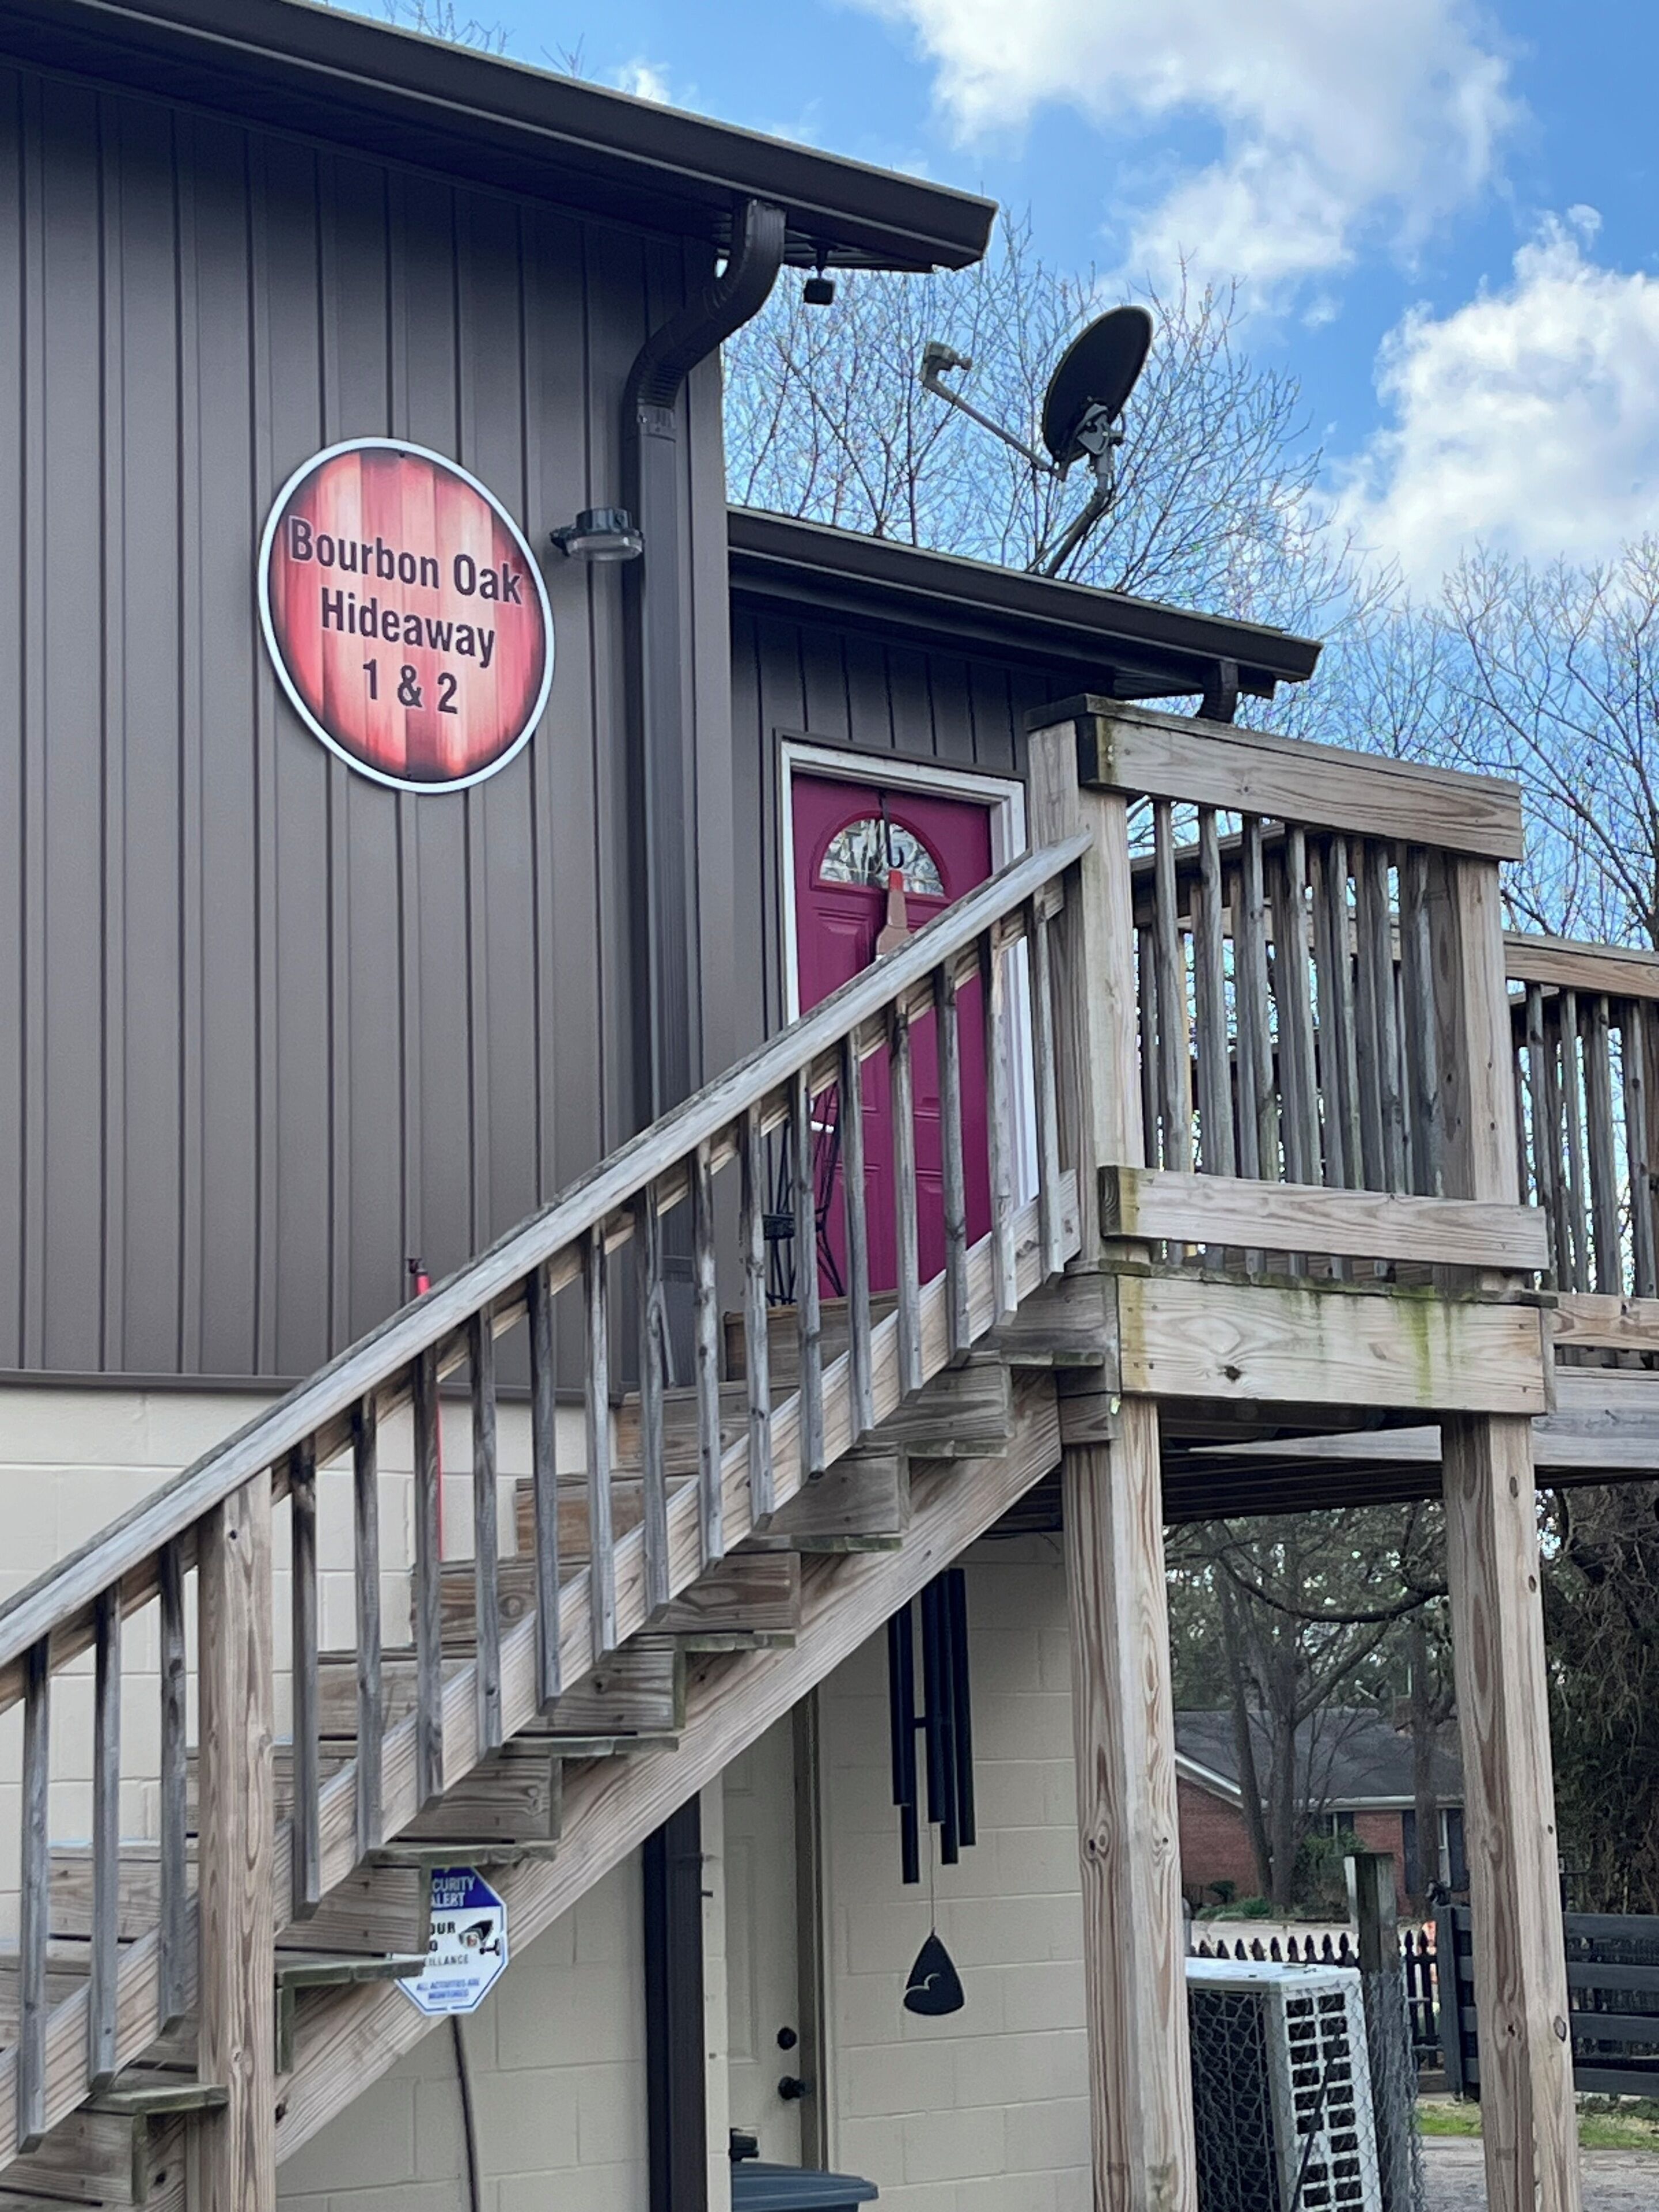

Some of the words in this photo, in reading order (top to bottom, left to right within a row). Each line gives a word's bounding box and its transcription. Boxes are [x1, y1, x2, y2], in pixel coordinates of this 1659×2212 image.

[291, 518, 439, 589] Bourbon
[453, 555, 521, 604] Oak
[321, 588, 494, 668] Hideaway
[362, 659, 378, 700] 1
[397, 665, 422, 707] &
[437, 672, 458, 714] 2
[432, 1876, 475, 1893] CURITY
[430, 1921, 456, 1935] OUR
